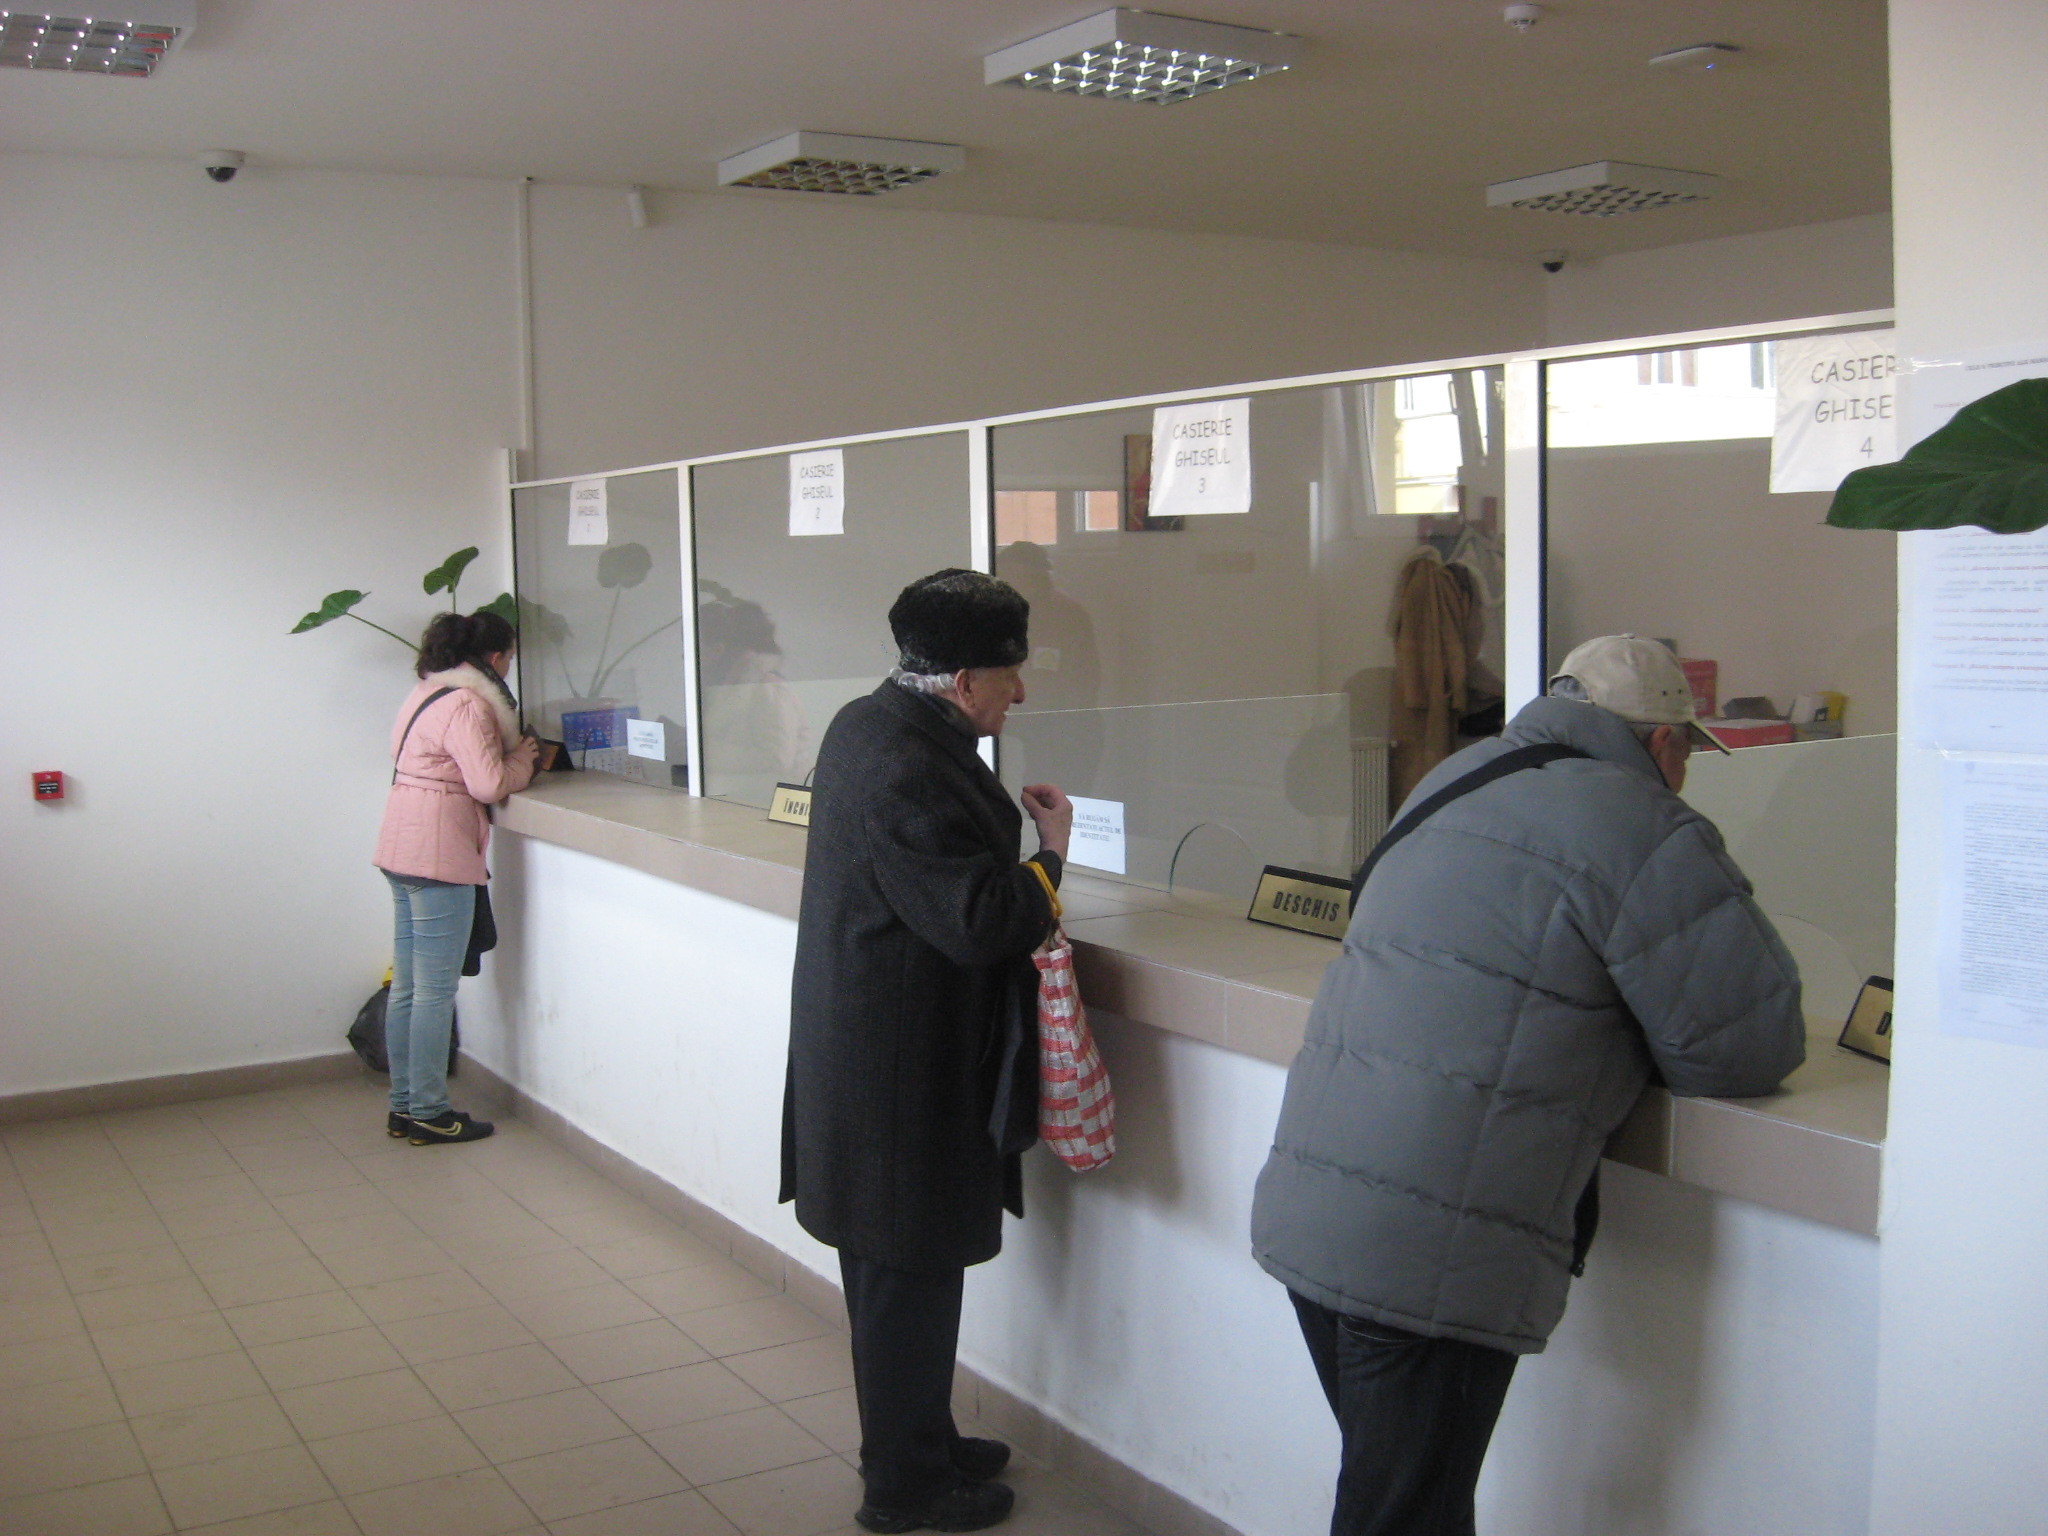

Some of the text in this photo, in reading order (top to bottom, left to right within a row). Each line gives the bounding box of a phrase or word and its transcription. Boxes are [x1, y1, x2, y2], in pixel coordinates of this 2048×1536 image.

[1815, 395, 1893, 424] GHISE
[1172, 417, 1233, 440] CASIERIE
[1175, 448, 1231, 468] GHISEUL
[1860, 436, 1874, 459] 4
[1198, 477, 1206, 494] 3
[1272, 890, 1341, 922] DESCHIS
